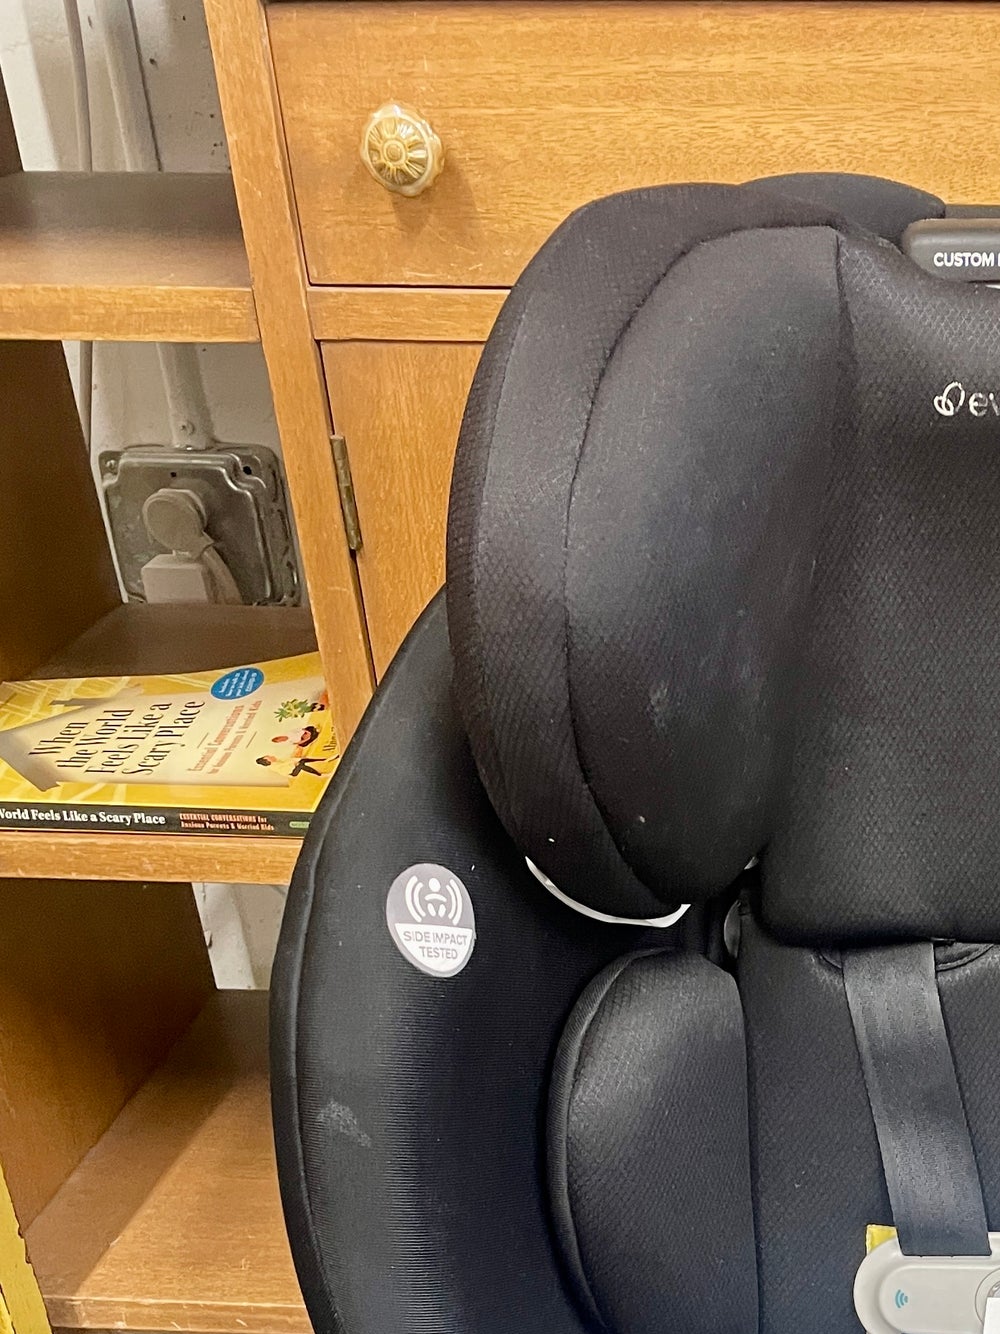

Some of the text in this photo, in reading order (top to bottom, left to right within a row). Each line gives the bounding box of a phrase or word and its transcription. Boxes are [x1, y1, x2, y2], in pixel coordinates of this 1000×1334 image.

[933, 252, 995, 267] CUSTOM
[28, 721, 90, 755] When
[55, 709, 135, 768] the World
[84, 702, 173, 773] Feels Like a
[122, 701, 206, 775] Scary Place
[30, 809, 61, 822] Feels
[62, 810, 89, 822] Like
[90, 814, 98, 822] a
[98, 811, 132, 826] Scary
[133, 812, 166, 825] Place
[403, 930, 468, 946] SIDE IMPACT
[418, 946, 459, 960] TESTED
